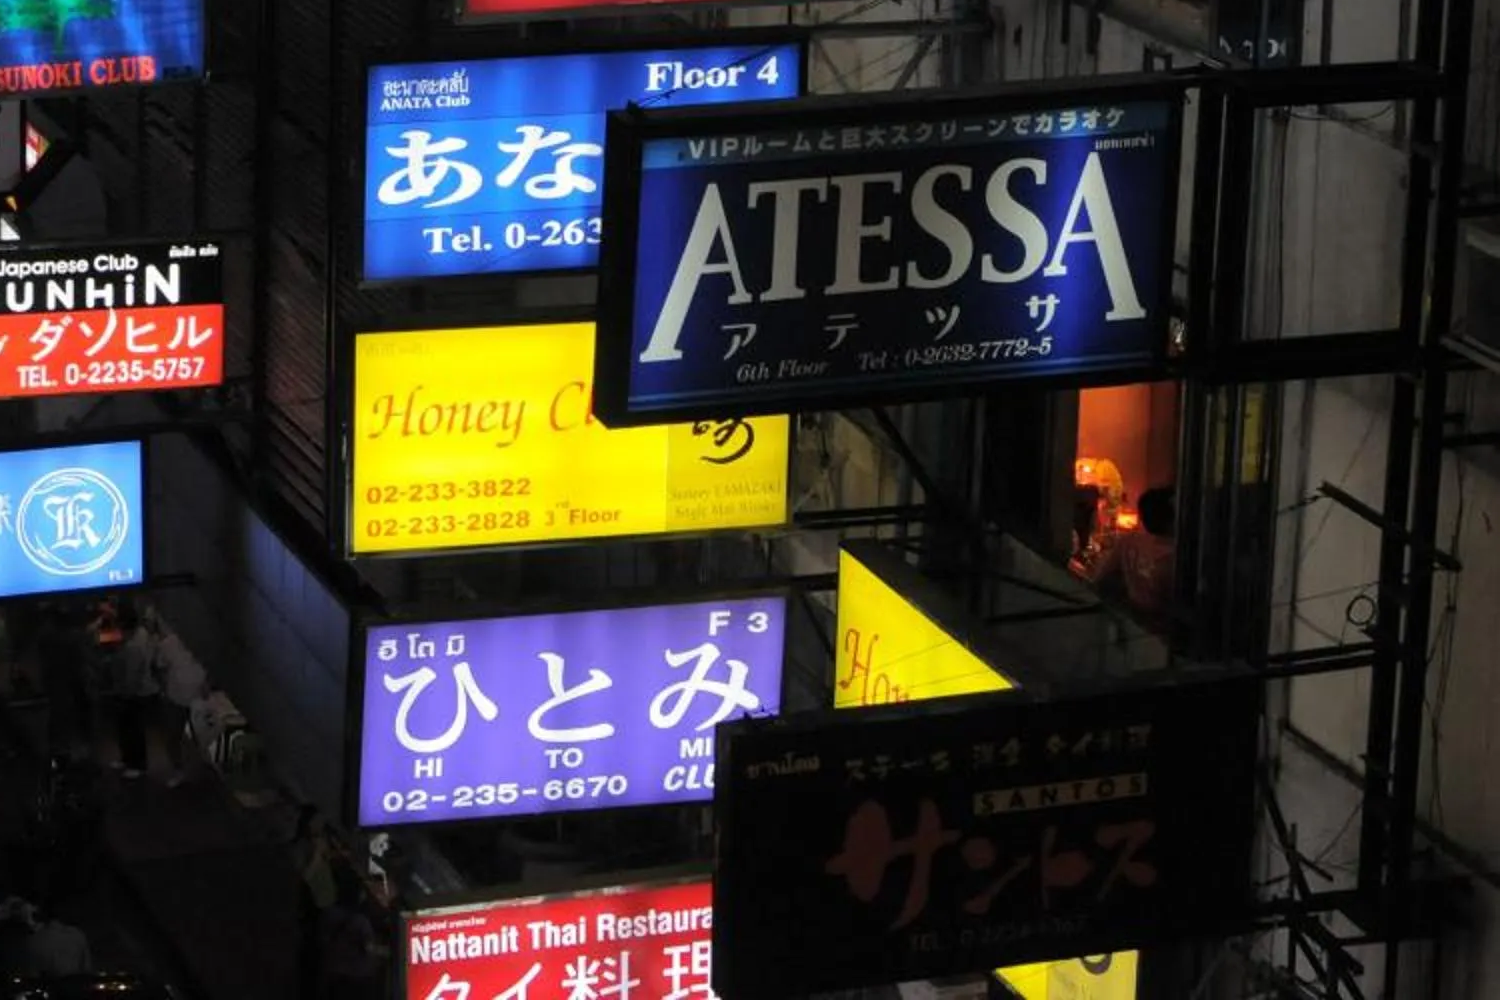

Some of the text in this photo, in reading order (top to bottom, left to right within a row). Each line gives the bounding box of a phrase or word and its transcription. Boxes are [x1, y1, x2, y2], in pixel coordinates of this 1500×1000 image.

[88, 56, 156, 85] CLUB
[645, 56, 780, 91] Floor 4
[381, 94, 471, 112] ANATA Club
[423, 226, 492, 253] Tel.
[93, 254, 139, 272] Club
[640, 150, 1146, 363] ATESSA
[17, 357, 205, 388] TEL. 0-2235-5757
[736, 361, 770, 383] 6th
[776, 355, 829, 378] Floor
[367, 384, 526, 448] Honey
[366, 477, 531, 505] 02-233-3822
[366, 510, 531, 537] 02-233-2828
[569, 507, 621, 526] Floor
[708, 611, 770, 636] F 3
[383, 642, 760, 753] ひとみ
[545, 748, 584, 770] TO
[680, 738, 714, 760] MI
[414, 758, 443, 778] HI
[383, 776, 628, 812] 02-235-6670
[981, 775, 1142, 817] SANTOS
[411, 926, 519, 965] Nattanit
[527, 917, 587, 949] Thai
